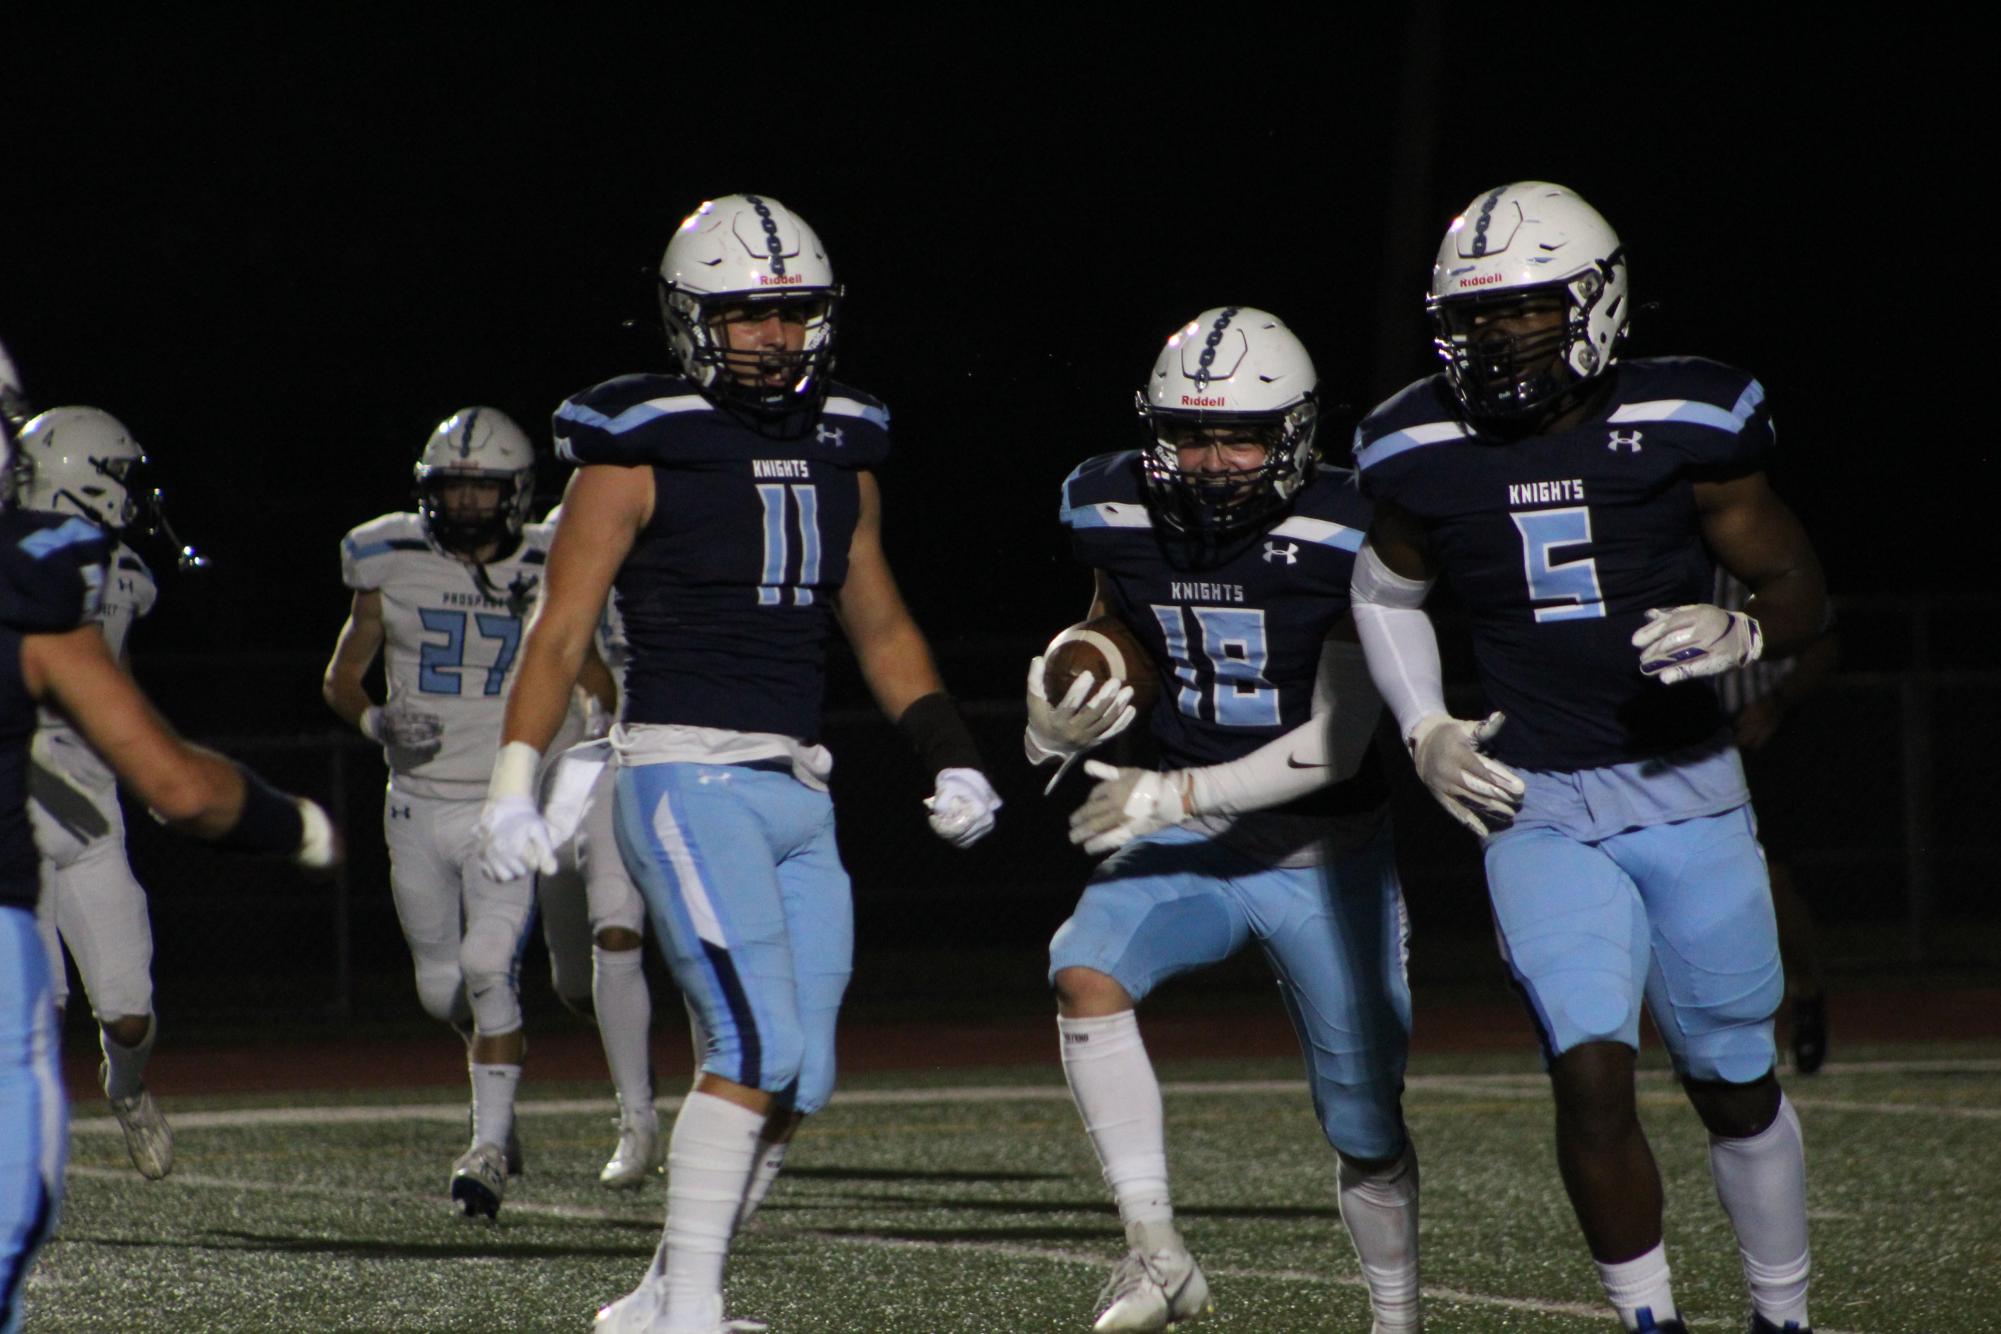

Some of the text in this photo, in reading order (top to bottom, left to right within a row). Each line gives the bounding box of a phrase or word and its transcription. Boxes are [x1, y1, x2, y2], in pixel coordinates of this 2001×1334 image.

[760, 275, 802, 286] Riddell
[1460, 273, 1502, 287] Riddell
[1182, 395, 1225, 406] Riddell
[752, 459, 810, 478] KNIGHTS
[1509, 478, 1584, 505] KNIGHTS
[754, 484, 822, 606] 11
[1509, 505, 1607, 624] 5
[1171, 582, 1245, 602] KNIGHTS
[418, 607, 522, 695] 27
[1149, 604, 1282, 726] 18
